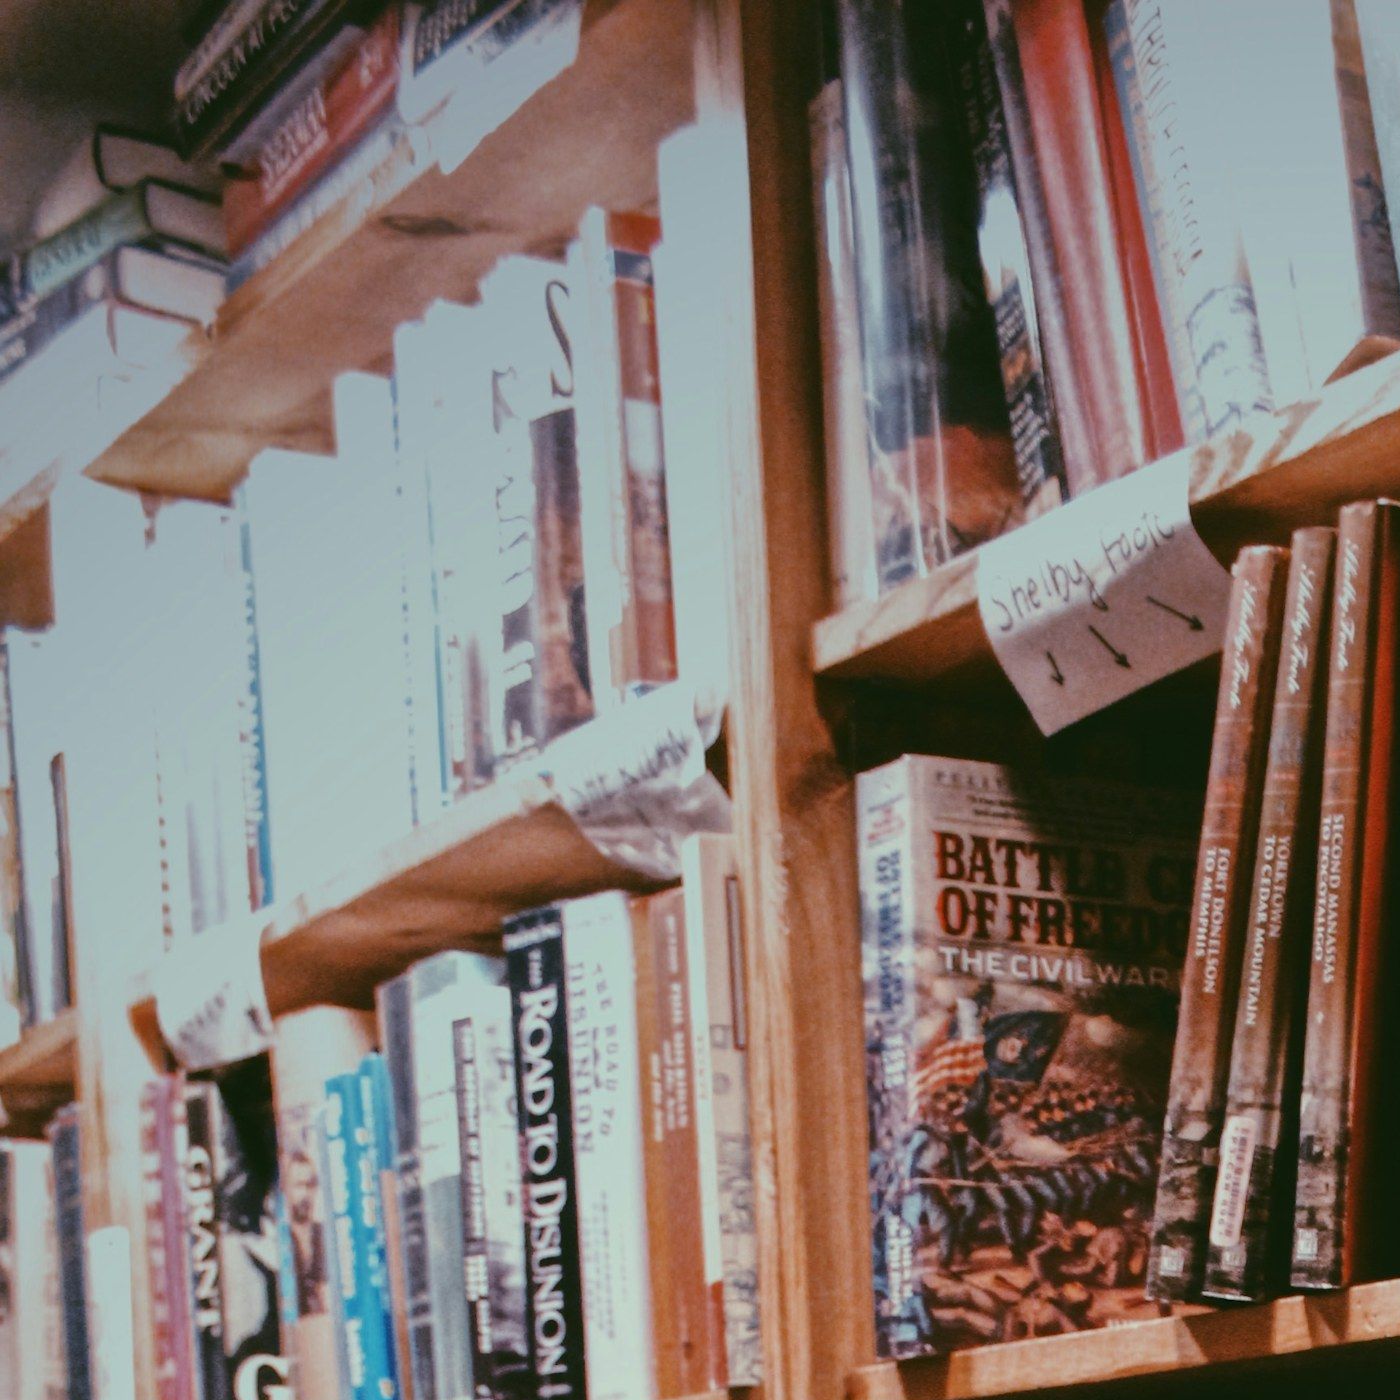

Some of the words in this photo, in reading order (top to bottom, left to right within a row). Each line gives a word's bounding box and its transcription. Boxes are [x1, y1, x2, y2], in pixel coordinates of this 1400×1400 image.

[992, 559, 1109, 632] Shelby
[936, 887, 1000, 940] OF
[939, 949, 1008, 977] THE
[1011, 953, 1093, 985] CIVIL
[1097, 962, 1171, 988] WAR
[516, 984, 561, 1116] ROAD
[525, 1113, 558, 1175] TO
[188, 1145, 221, 1329] GRANT
[526, 1178, 569, 1376] DISUNION
